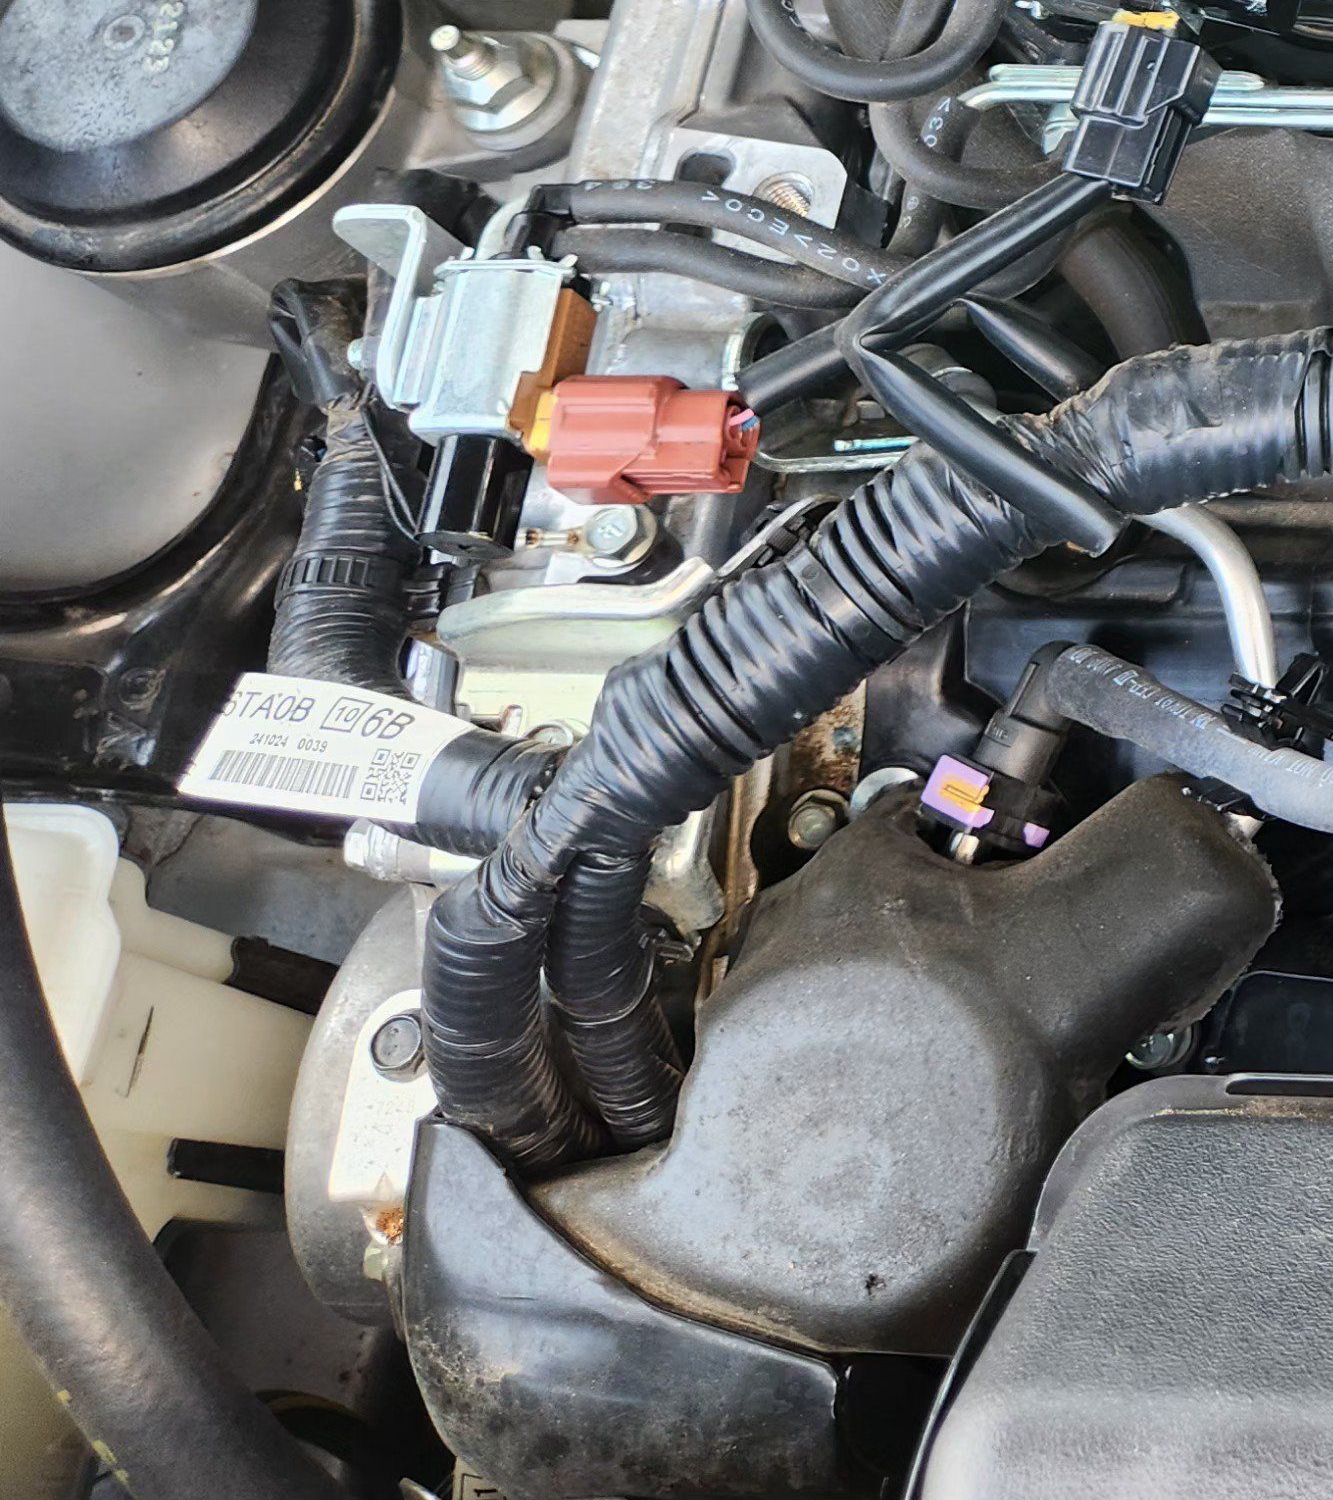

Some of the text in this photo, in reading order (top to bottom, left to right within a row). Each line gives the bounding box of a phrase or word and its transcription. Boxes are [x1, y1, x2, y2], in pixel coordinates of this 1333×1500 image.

[334, 705, 359, 723] 10
[362, 708, 416, 740] 6B
[249, 732, 289, 748] 241024
